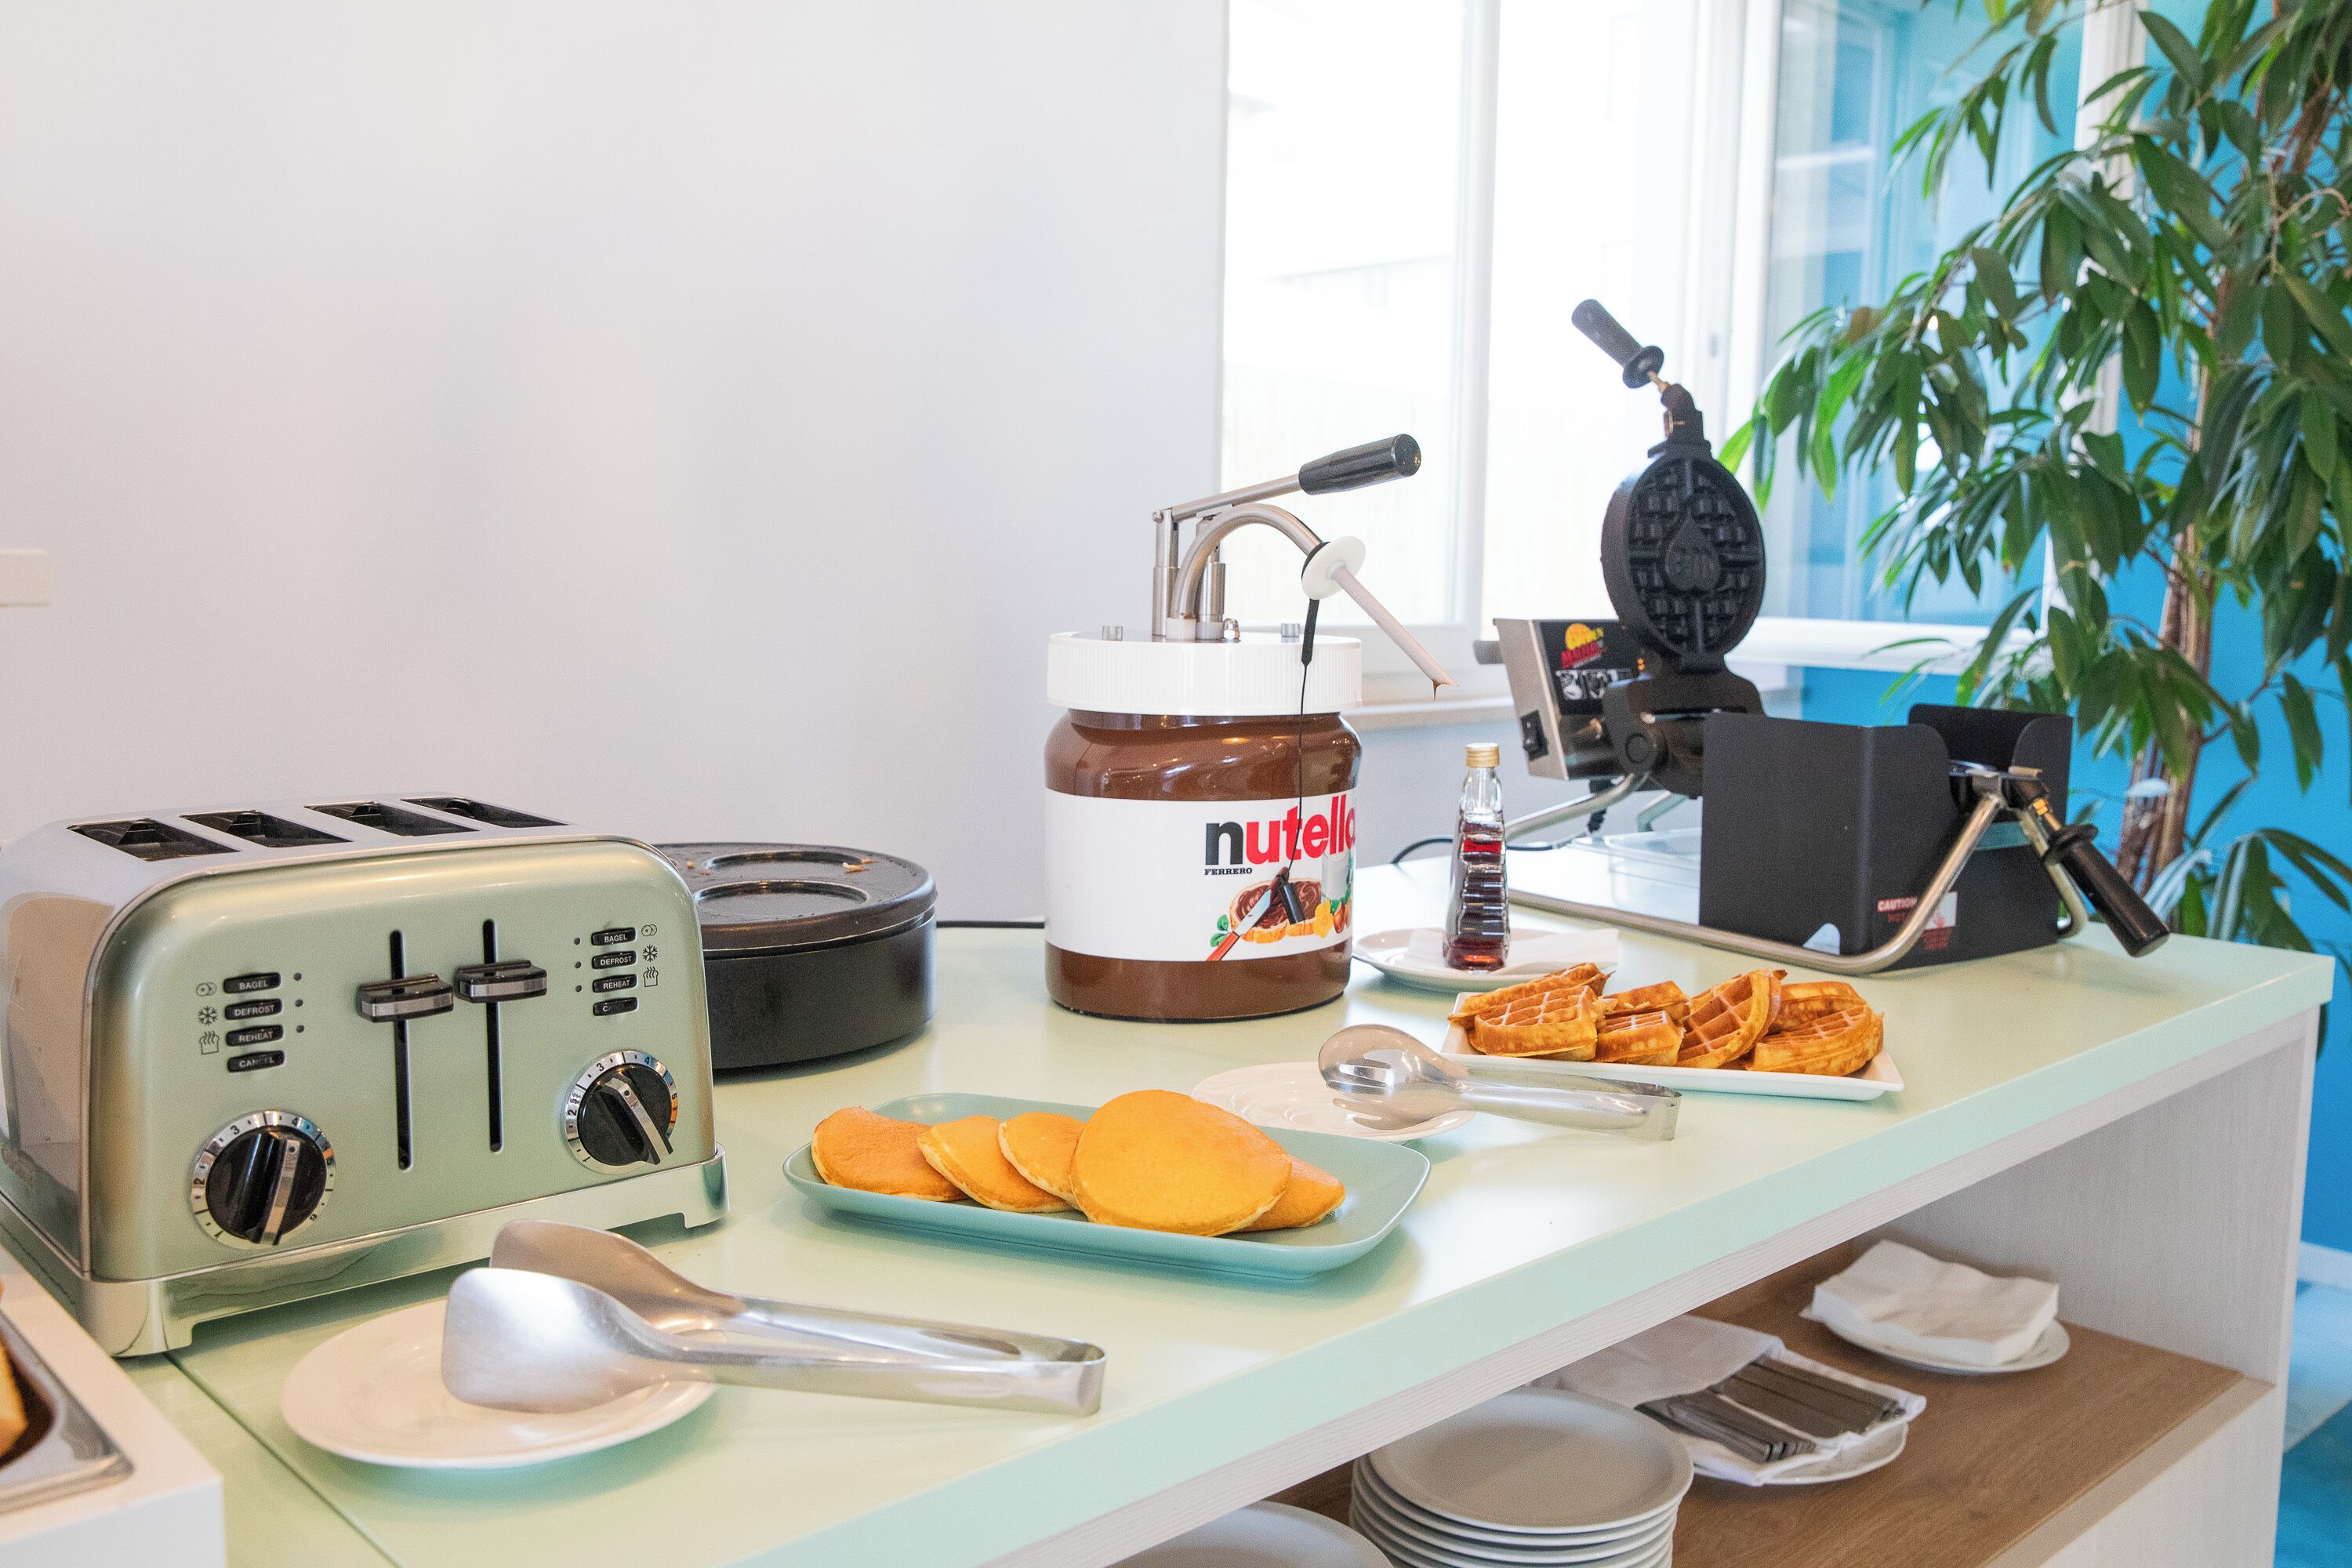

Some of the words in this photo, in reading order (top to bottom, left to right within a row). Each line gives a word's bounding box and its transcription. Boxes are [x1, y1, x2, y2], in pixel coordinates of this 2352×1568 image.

[1205, 793, 1356, 866] nutella
[1204, 867, 1253, 876] FERRERO
[604, 934, 627, 943] BAGEL
[601, 956, 632, 966] DEFROST
[239, 980, 269, 990] BAGEL
[603, 980, 631, 989] REHEAT
[234, 1004, 275, 1017] DEFROST
[238, 1032, 274, 1042] REHEAT
[239, 1056, 274, 1068] CANL
[596, 1062, 605, 1072] 3
[230, 1125, 241, 1135] 3
